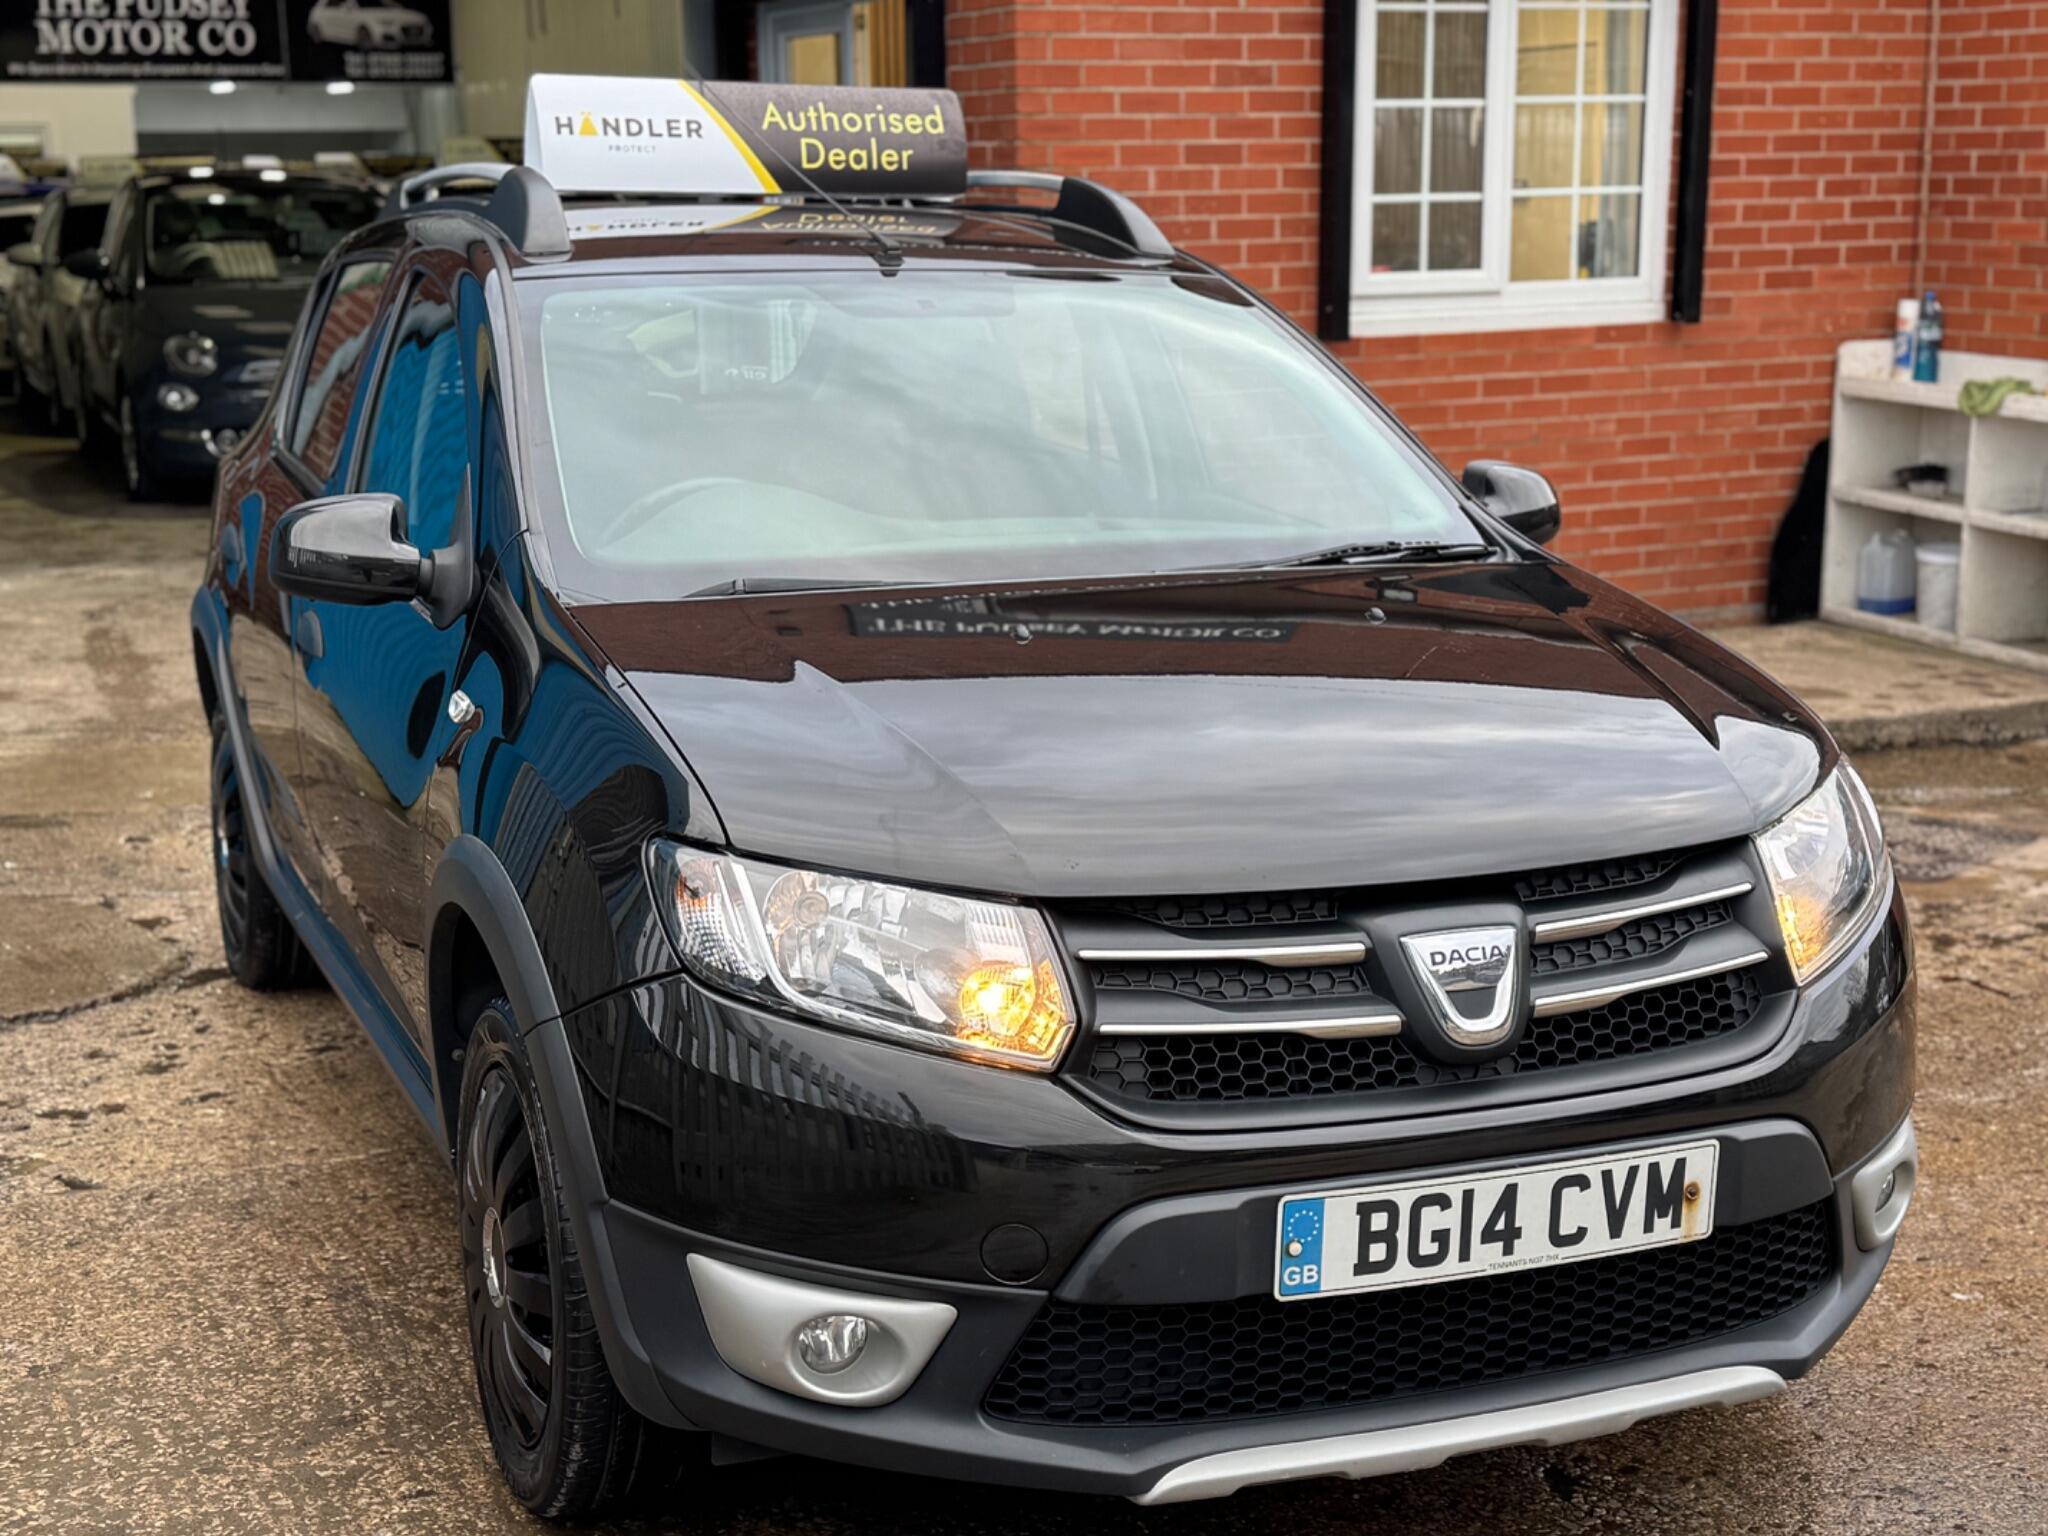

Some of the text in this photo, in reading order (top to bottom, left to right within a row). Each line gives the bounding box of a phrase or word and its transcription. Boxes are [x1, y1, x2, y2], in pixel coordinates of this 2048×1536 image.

[34, 18, 257, 56] MOTOR CO
[761, 101, 945, 135] Authorised
[608, 144, 656, 153] PROTECT
[800, 138, 914, 171] Dealer
[1430, 945, 1505, 966] DACIA
[1353, 1157, 1688, 1277] BG14 CVM
[1283, 1264, 1319, 1286] GB
